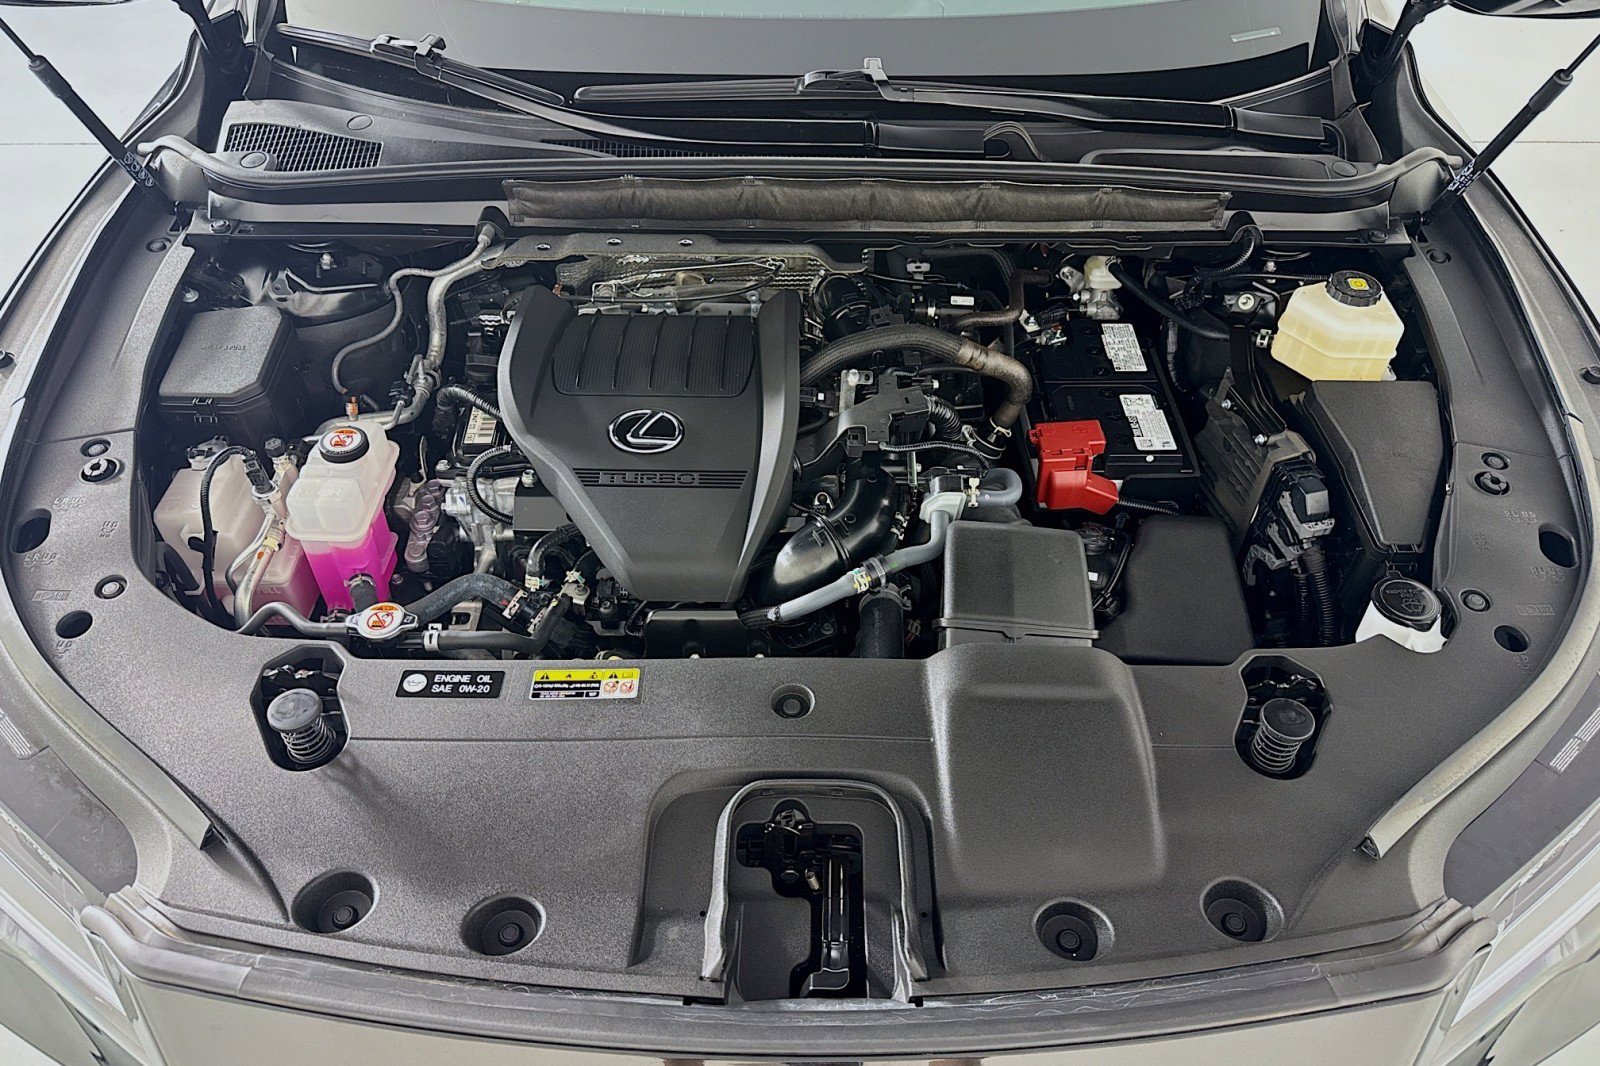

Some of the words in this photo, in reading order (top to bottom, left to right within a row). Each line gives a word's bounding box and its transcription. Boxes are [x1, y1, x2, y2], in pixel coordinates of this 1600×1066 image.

[602, 472, 696, 485] TURBO
[431, 685, 452, 693] SAE
[459, 685, 490, 693] 0W-20
